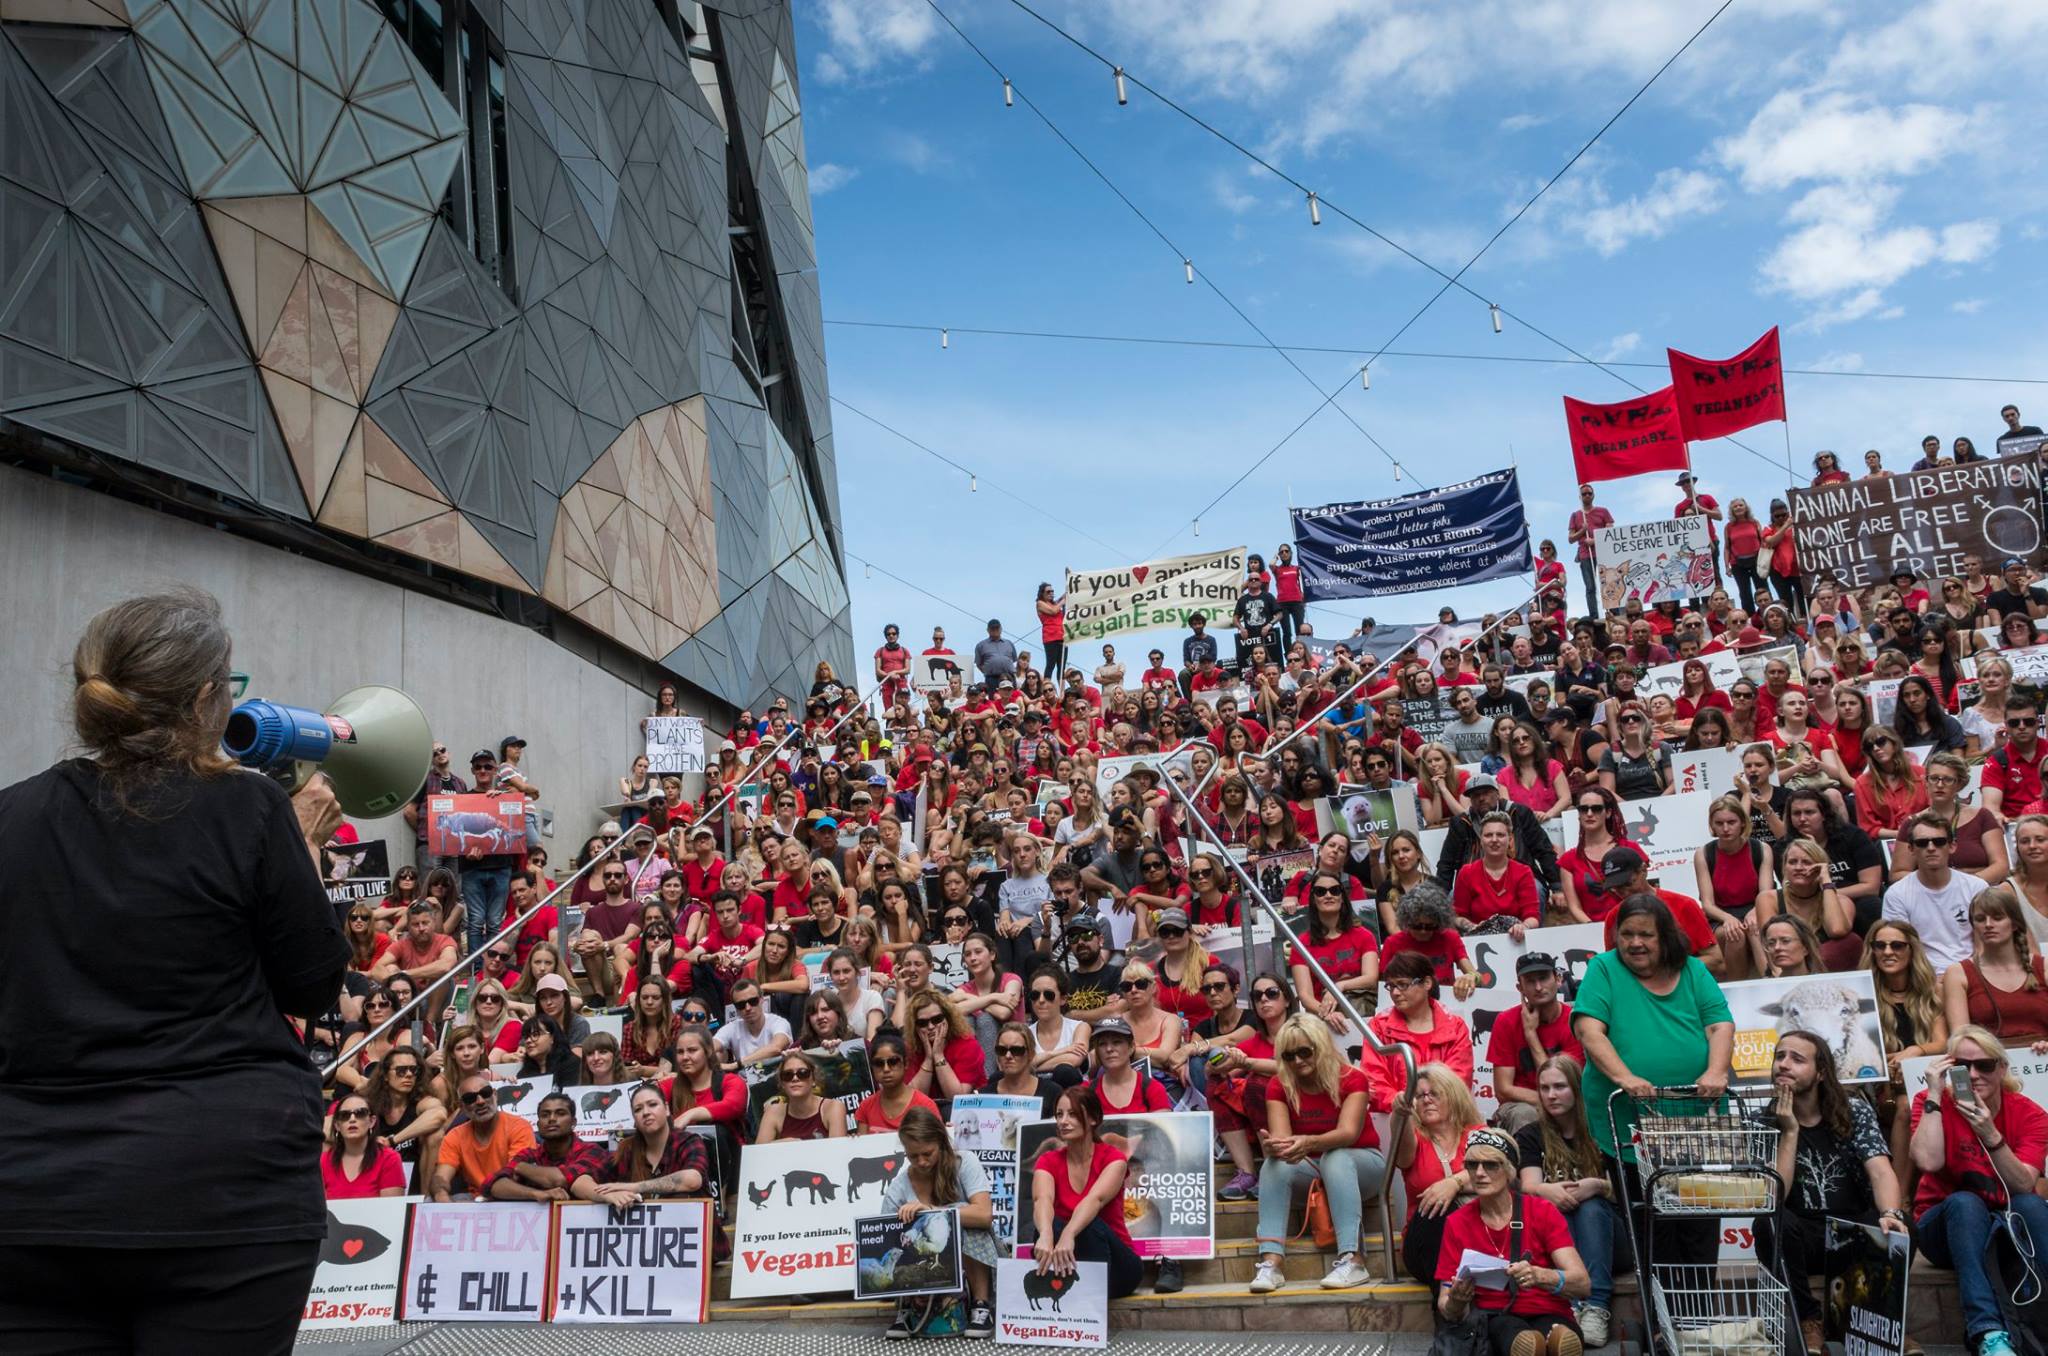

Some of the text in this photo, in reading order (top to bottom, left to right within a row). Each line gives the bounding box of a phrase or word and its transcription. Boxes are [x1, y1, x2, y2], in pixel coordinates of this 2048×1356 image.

[1794, 461, 2041, 523] ANIMAL LIBERATION
[1362, 502, 1446, 529] protect your health
[1362, 528, 1399, 544] demand
[1402, 519, 1431, 535] better
[1604, 528, 1627, 543] ALL
[1798, 502, 1971, 551] NONE ARE FREE
[1412, 534, 1442, 549] HAVE
[1444, 526, 1483, 542] RIGHTS
[1613, 532, 1690, 554] DESERVE LIFE
[1326, 540, 1497, 574] support Aussie crop farmers
[1803, 528, 1960, 573] UNTIL ALL
[1406, 566, 1432, 578] more
[1438, 558, 1471, 574] violent
[1478, 556, 1489, 568] at
[1496, 551, 1523, 564] home
[1068, 575, 1081, 594] If
[1089, 573, 1131, 596] you
[1066, 579, 1238, 622] don't eat them
[1240, 635, 1272, 646] VOTE 1
[1408, 701, 1432, 711] END
[1411, 710, 1436, 722] THE
[647, 727, 703, 745] PLANTS
[647, 752, 704, 772] PROTEIN
[1357, 819, 1390, 834] LOVE
[352, 883, 365, 897] TO
[366, 881, 387, 896] LIVE
[1740, 1055, 1774, 1068] MEA
[2022, 1065, 2032, 1075] &
[958, 1098, 1031, 1109] family dinner
[976, 1151, 1010, 1162] VEGAN
[1138, 1172, 1207, 1186] CHOOSE
[1124, 1185, 1207, 1200] MPASSION
[607, 1204, 662, 1226] NOT
[1171, 1199, 1207, 1212] FOR
[861, 1221, 904, 1233] Meet your
[1170, 1211, 1207, 1226] PIGS
[416, 1211, 544, 1252] NETFLIX
[742, 1225, 852, 1244] If you love animals,
[861, 1234, 884, 1246] meat
[565, 1226, 699, 1268] TORTURE
[741, 1243, 856, 1277] VeganE
[310, 1286, 327, 1294] als,
[328, 1284, 352, 1293] don't
[370, 1282, 397, 1291] them.
[458, 1271, 538, 1312] CHILL
[1001, 1323, 1100, 1342] VeganEasy.org
[1850, 1304, 1901, 1347] SLAUGHTER IS
